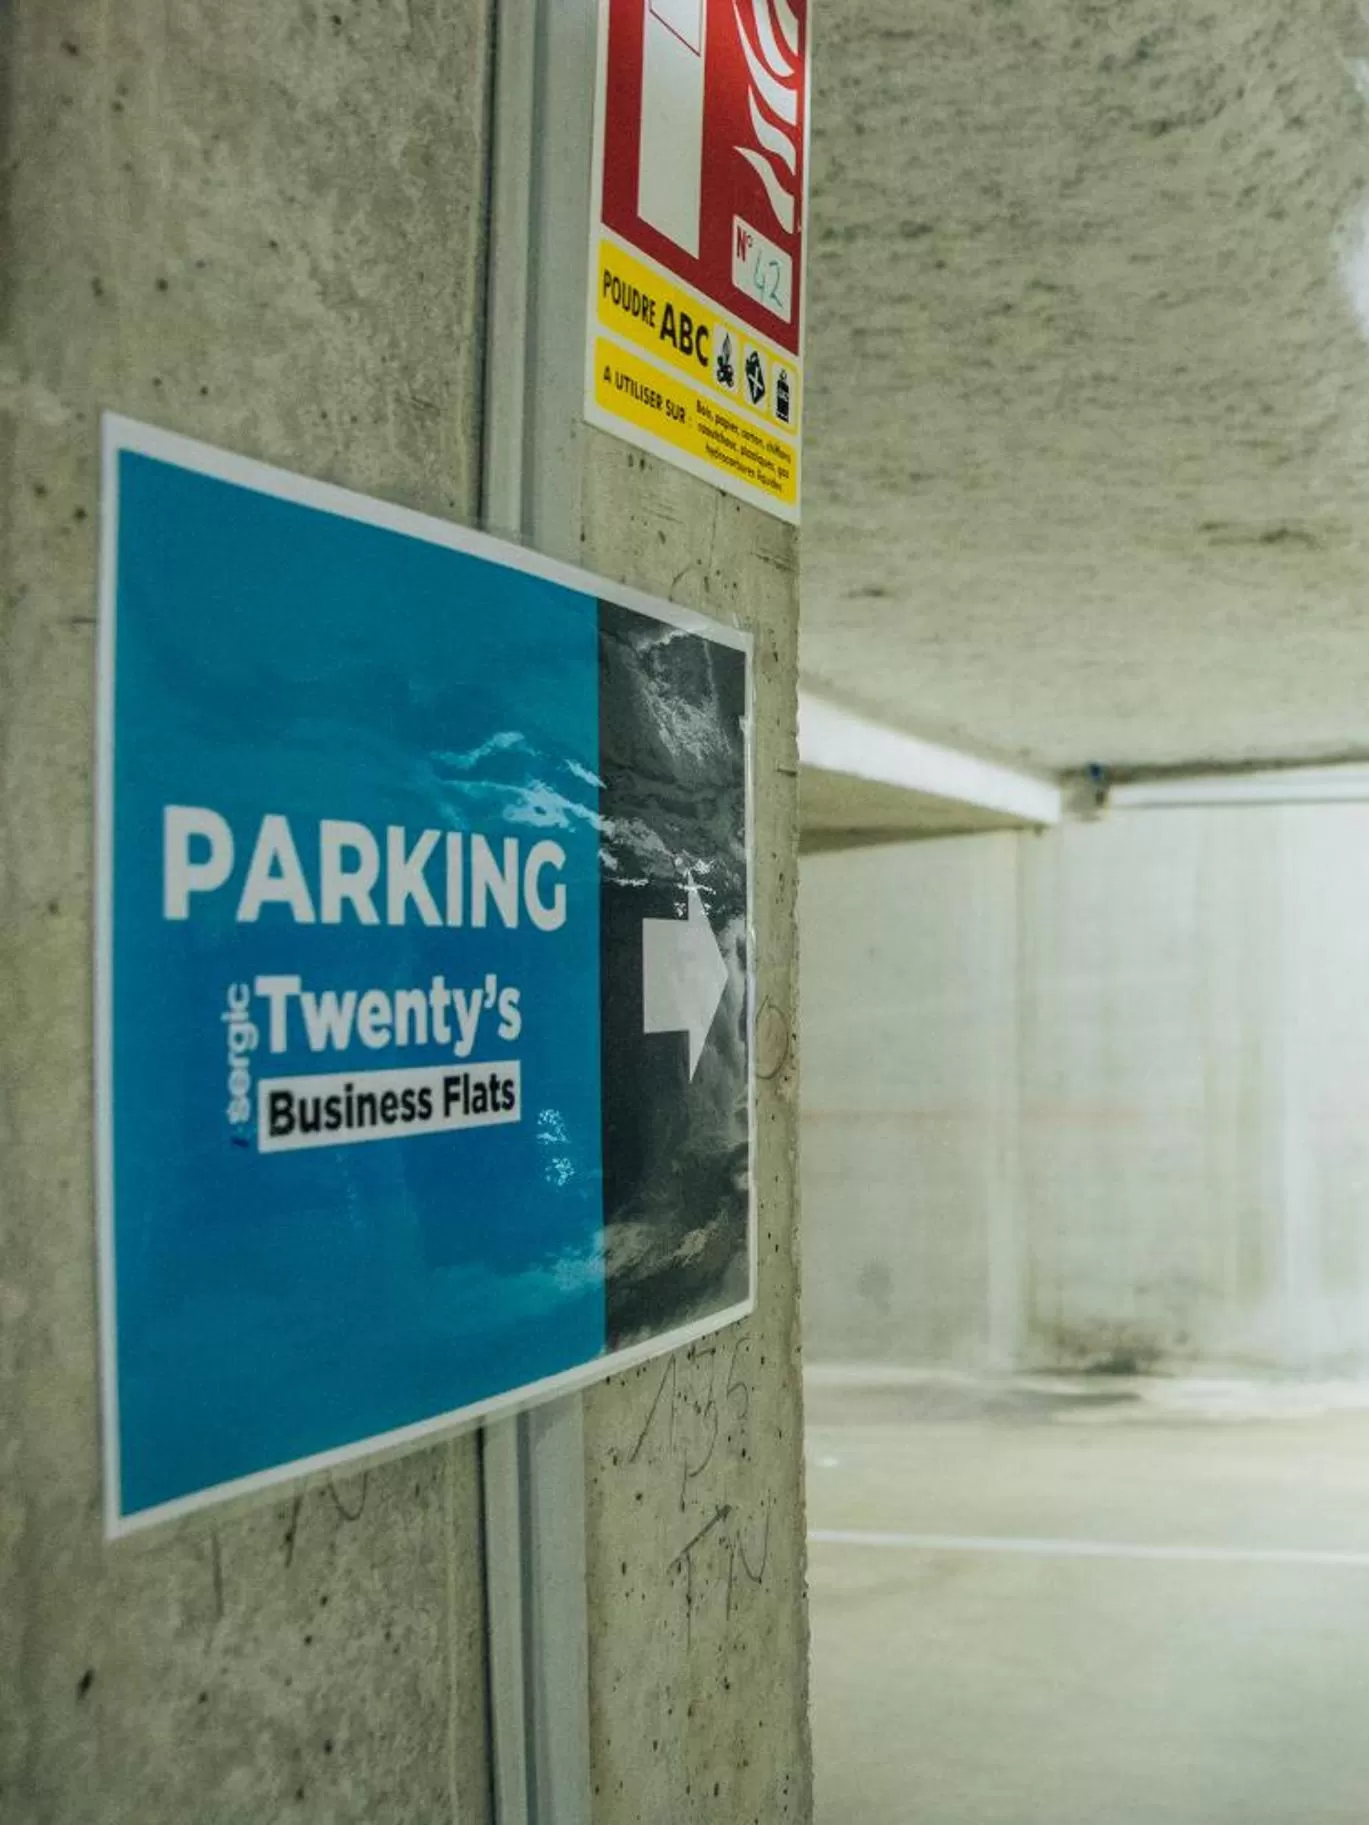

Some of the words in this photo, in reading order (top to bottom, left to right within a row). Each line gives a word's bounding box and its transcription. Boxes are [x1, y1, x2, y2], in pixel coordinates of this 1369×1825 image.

[603, 268, 656, 329] POUDRE
[660, 301, 709, 367] ABC
[753, 249, 783, 307] 42
[603, 365, 612, 385] A
[614, 371, 662, 411] UTILISER
[665, 399, 686, 424] SUR
[162, 804, 568, 932] PARKING
[221, 983, 259, 1125] sergic
[254, 973, 522, 1058] Twenty's
[268, 1082, 432, 1138] Business
[443, 1073, 516, 1118] Flats
